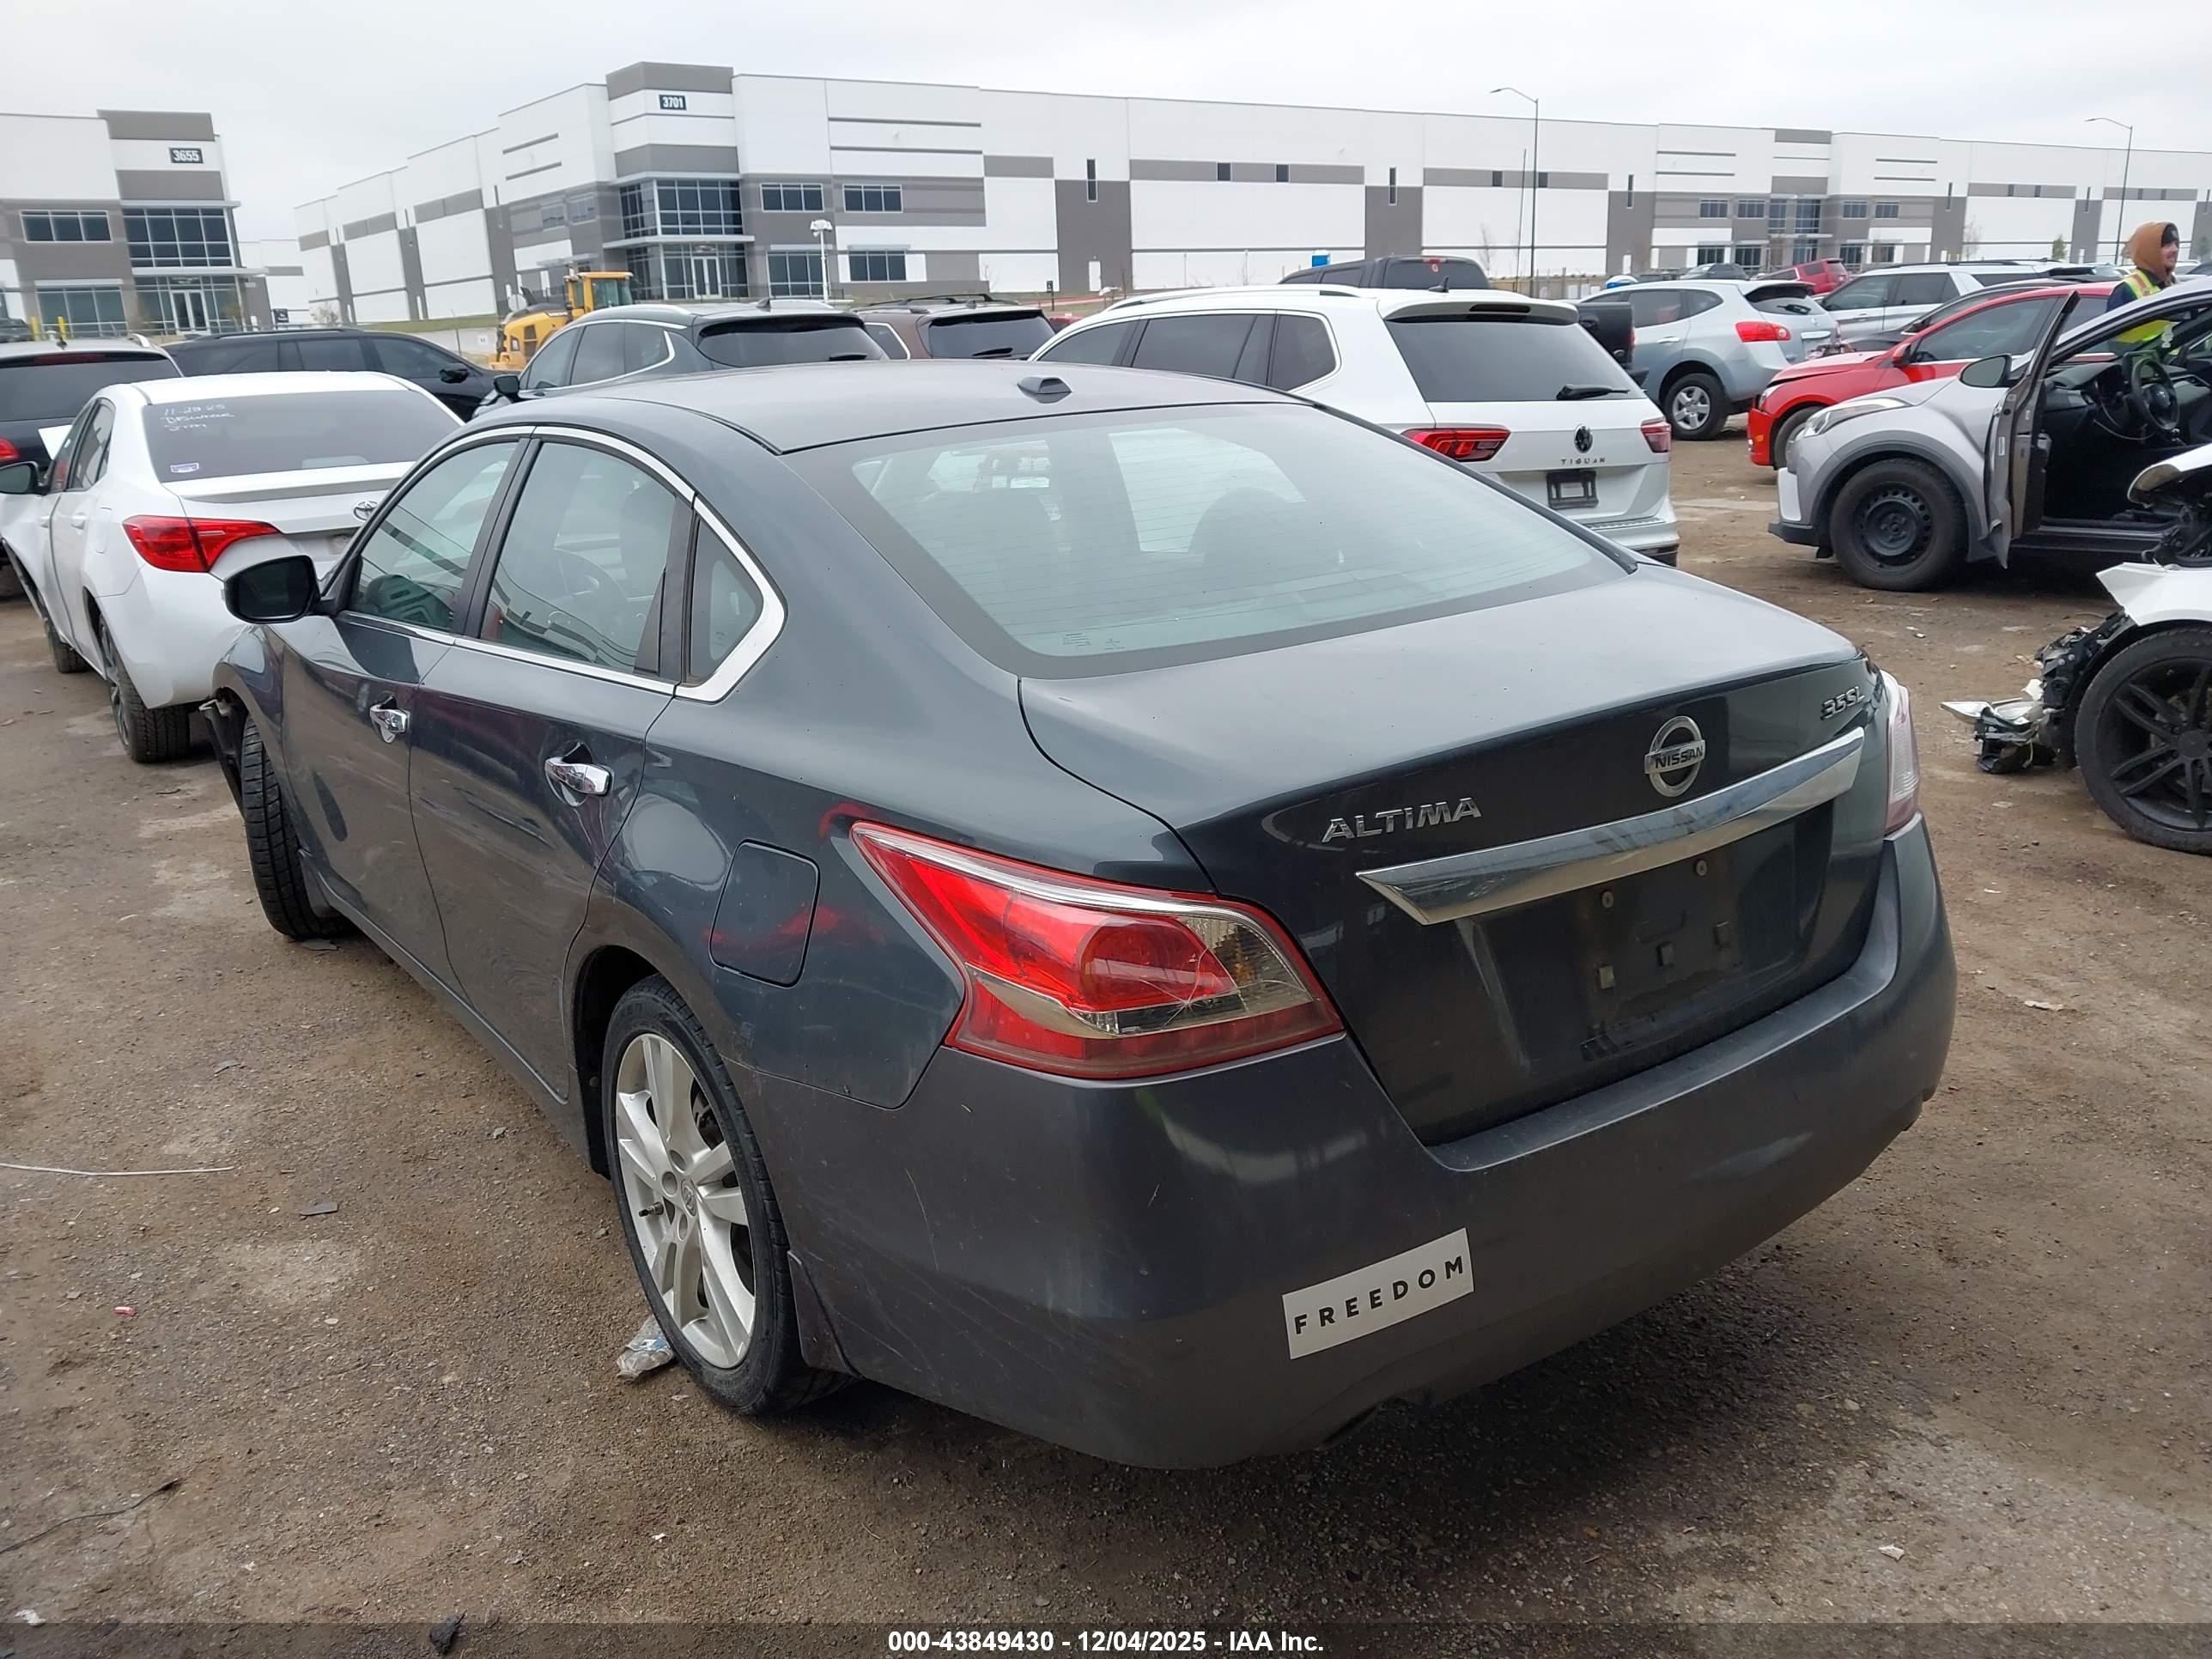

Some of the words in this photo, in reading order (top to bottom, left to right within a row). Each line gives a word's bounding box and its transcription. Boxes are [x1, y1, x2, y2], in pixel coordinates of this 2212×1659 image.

[662, 95, 684, 109] 3701
[173, 149, 200, 162] 3655
[1560, 457, 1606, 465] TIGUAN
[1655, 744, 1704, 769] NISSAN
[1321, 797, 1483, 844] ALTIMA
[1294, 1255, 1464, 1334] FREEDOM
